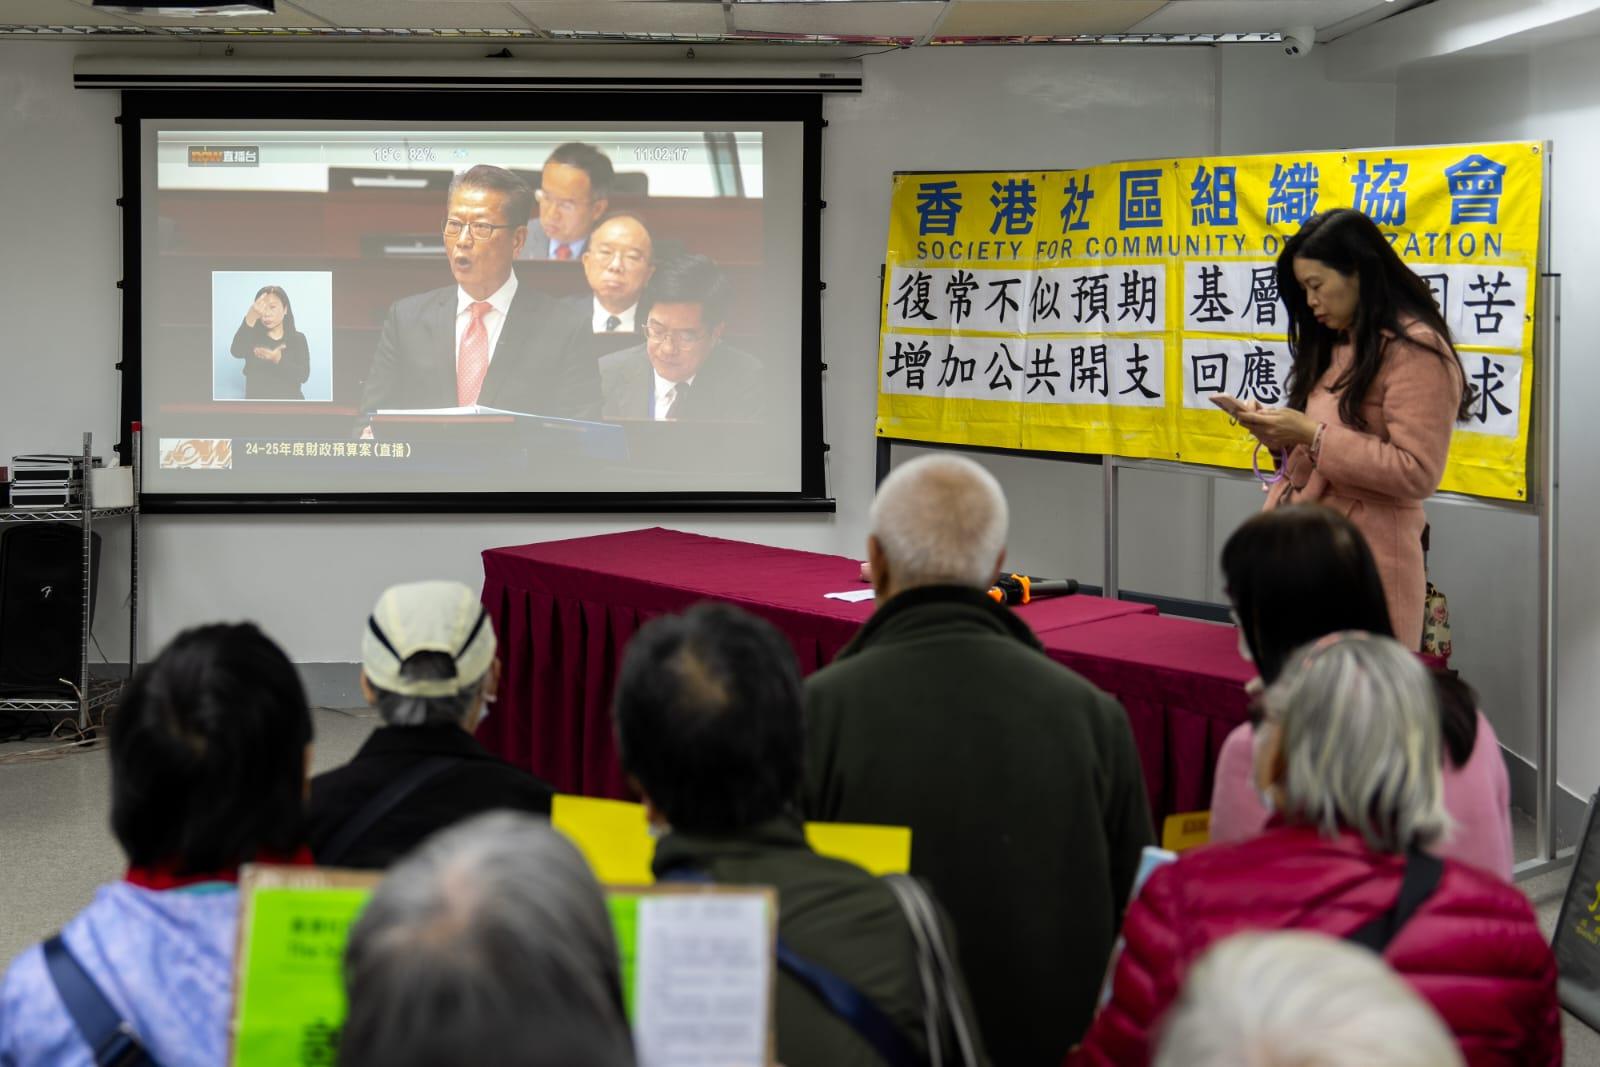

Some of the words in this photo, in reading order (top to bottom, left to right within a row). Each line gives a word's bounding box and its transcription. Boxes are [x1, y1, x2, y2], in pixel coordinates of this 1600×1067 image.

[408, 147, 437, 161] 82%
[634, 147, 689, 161] 11:02:17
[916, 154, 1507, 236] 香港社區組織協會
[917, 240, 1023, 260] SOCIETY
[1037, 239, 1072, 260] FOR
[1086, 234, 1246, 258] COMMUNITY
[893, 269, 1157, 325] 復常不似預期
[886, 341, 1161, 399] 增加公共開支
